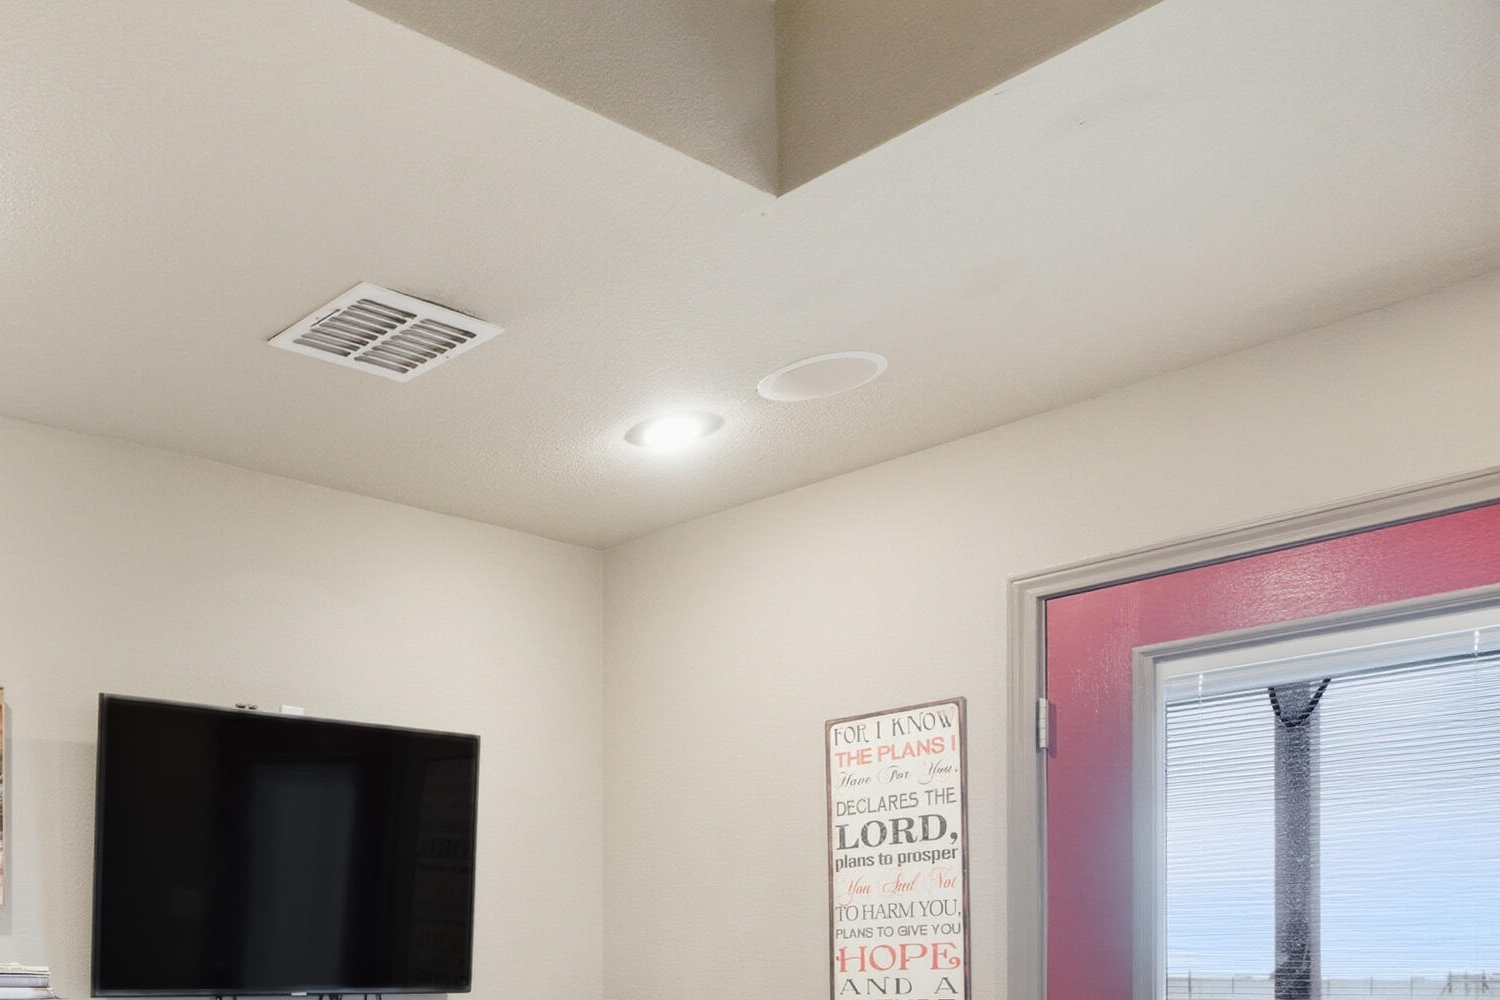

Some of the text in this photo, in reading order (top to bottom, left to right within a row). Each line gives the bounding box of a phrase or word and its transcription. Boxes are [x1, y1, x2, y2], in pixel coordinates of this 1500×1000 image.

[834, 709, 955, 745] FOR I KNOW
[835, 748, 872, 768] THE
[877, 736, 945, 762] PLANS
[837, 771, 871, 788] Have
[836, 787, 956, 816] DECLARES THE
[835, 814, 958, 850] LORD,
[835, 848, 958, 872] plans to prosper
[835, 899, 961, 921] TO HARM YOU,
[836, 923, 961, 939] PLANS TO GIVE YOU
[836, 942, 961, 972] HOPE
[840, 977, 959, 995] AND A
